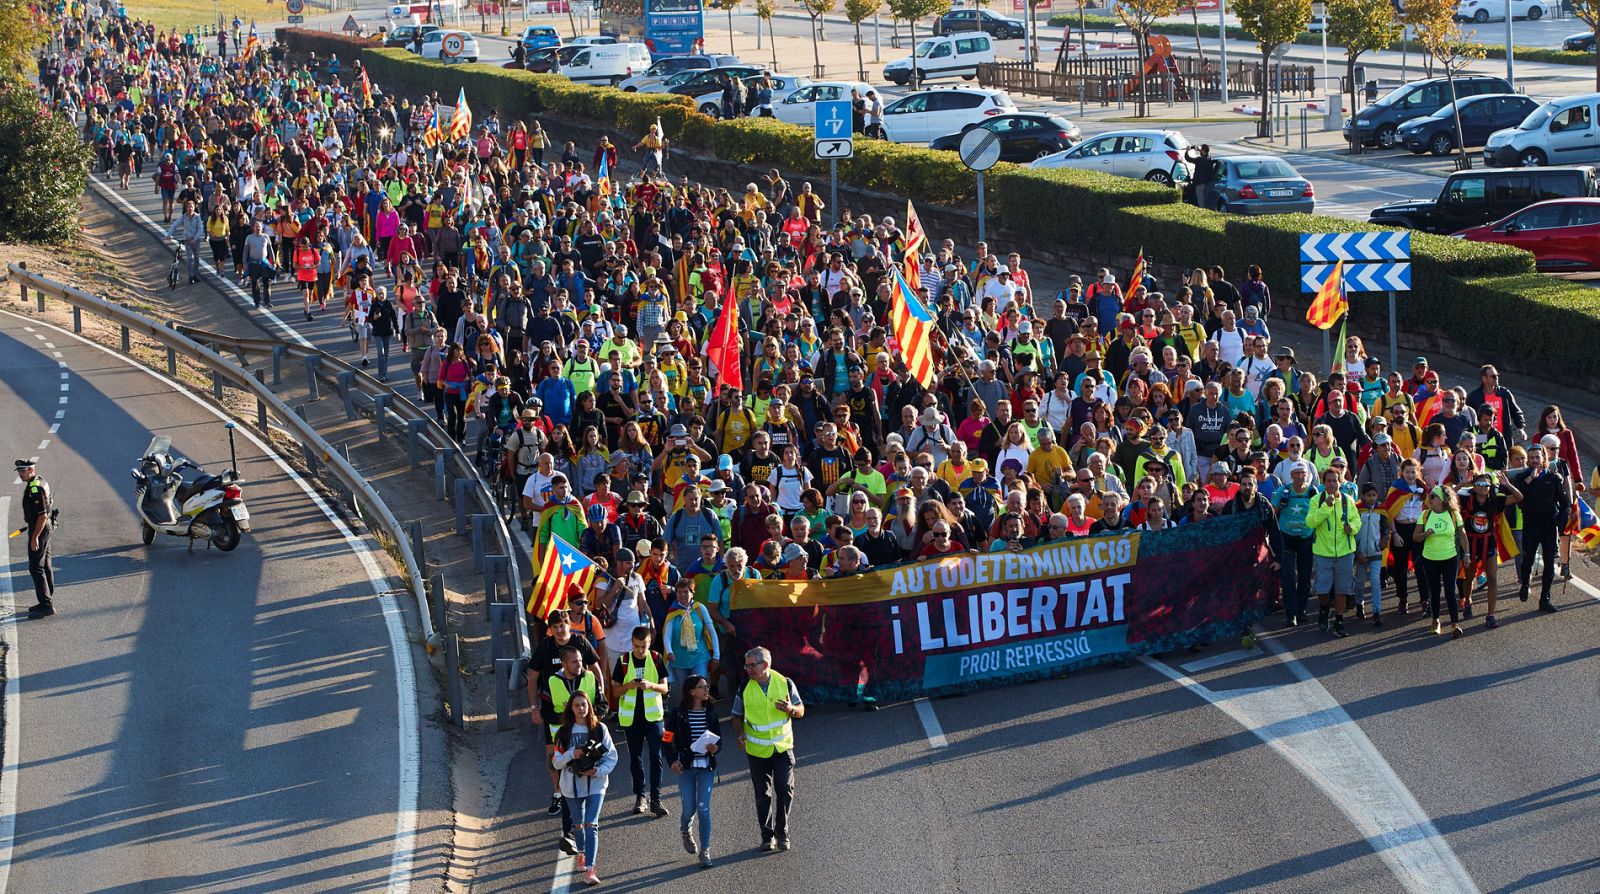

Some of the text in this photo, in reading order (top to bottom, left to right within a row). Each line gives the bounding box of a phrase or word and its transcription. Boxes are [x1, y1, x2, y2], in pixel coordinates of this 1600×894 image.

[448, 40, 460, 49] 70
[890, 533, 1131, 596] AUTODETERMINACIÓ
[916, 573, 1132, 650] LLIBERTAT
[960, 631, 1092, 677] PROU REPRESSIÓ
